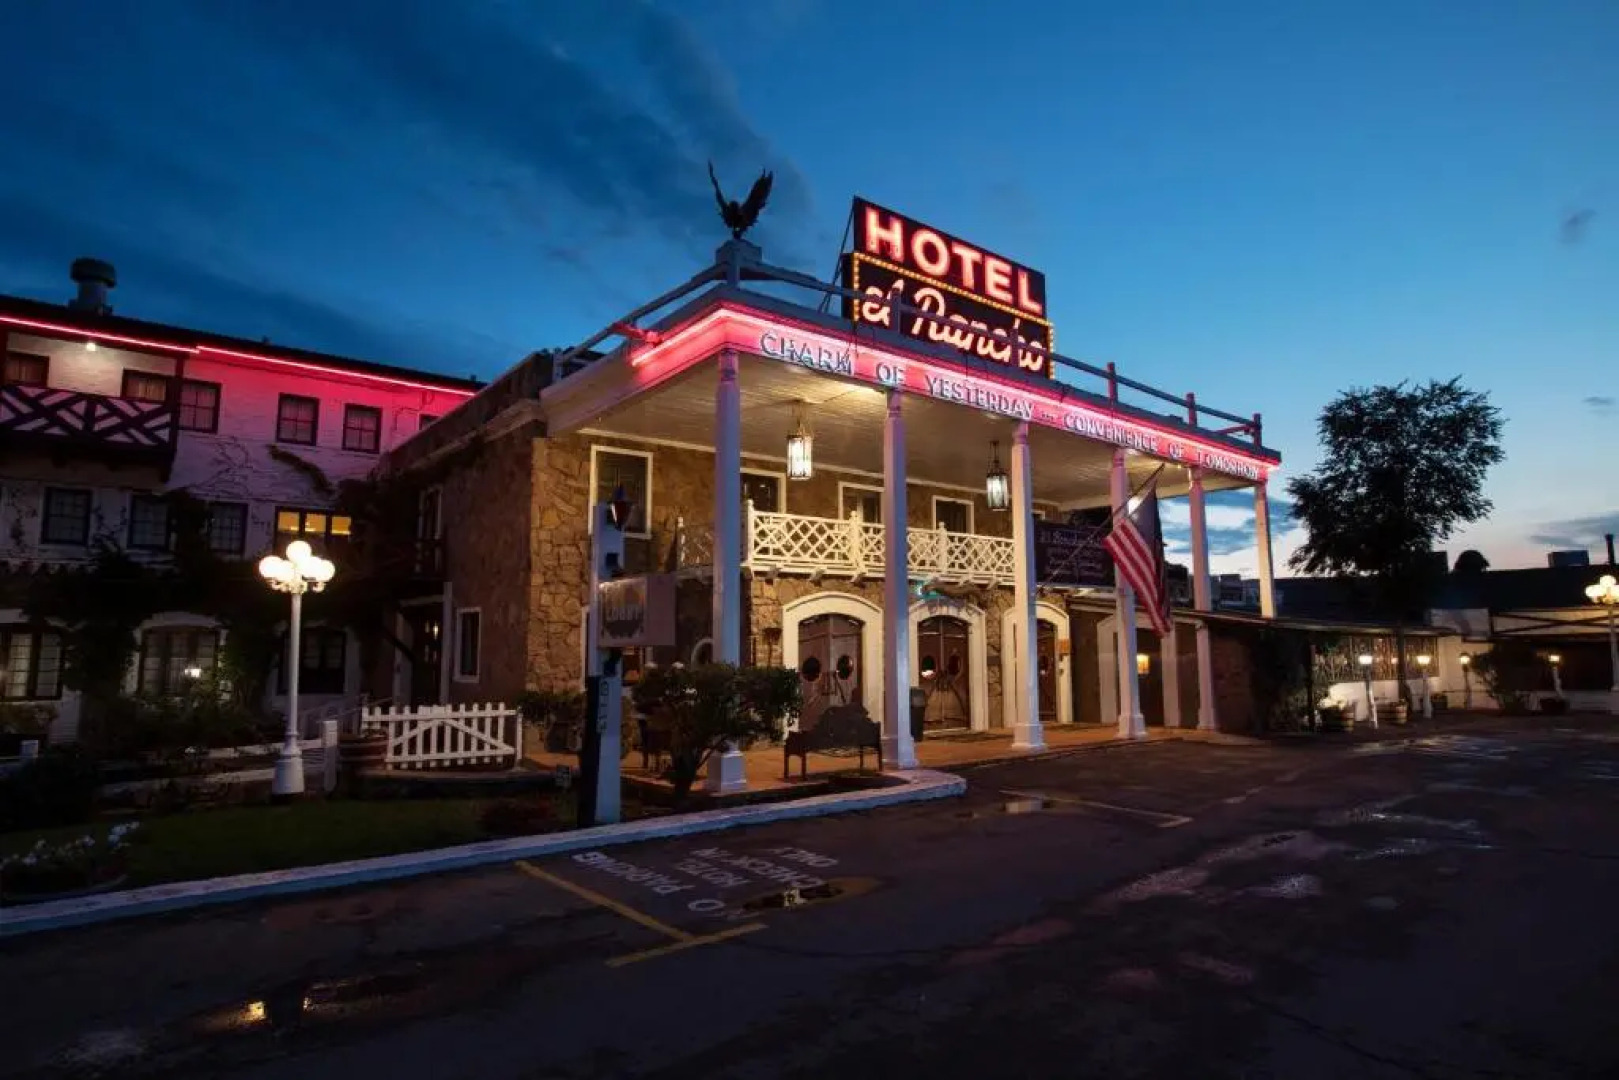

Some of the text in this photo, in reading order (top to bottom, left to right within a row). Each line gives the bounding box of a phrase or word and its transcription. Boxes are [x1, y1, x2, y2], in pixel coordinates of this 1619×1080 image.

[864, 206, 1043, 315] HOTEL
[760, 332, 852, 375] CHARM
[875, 361, 906, 385] OF
[924, 374, 1034, 420] YESTERDAY
[1063, 412, 1158, 454] CONVENIENCE
[1169, 442, 1184, 459] OF
